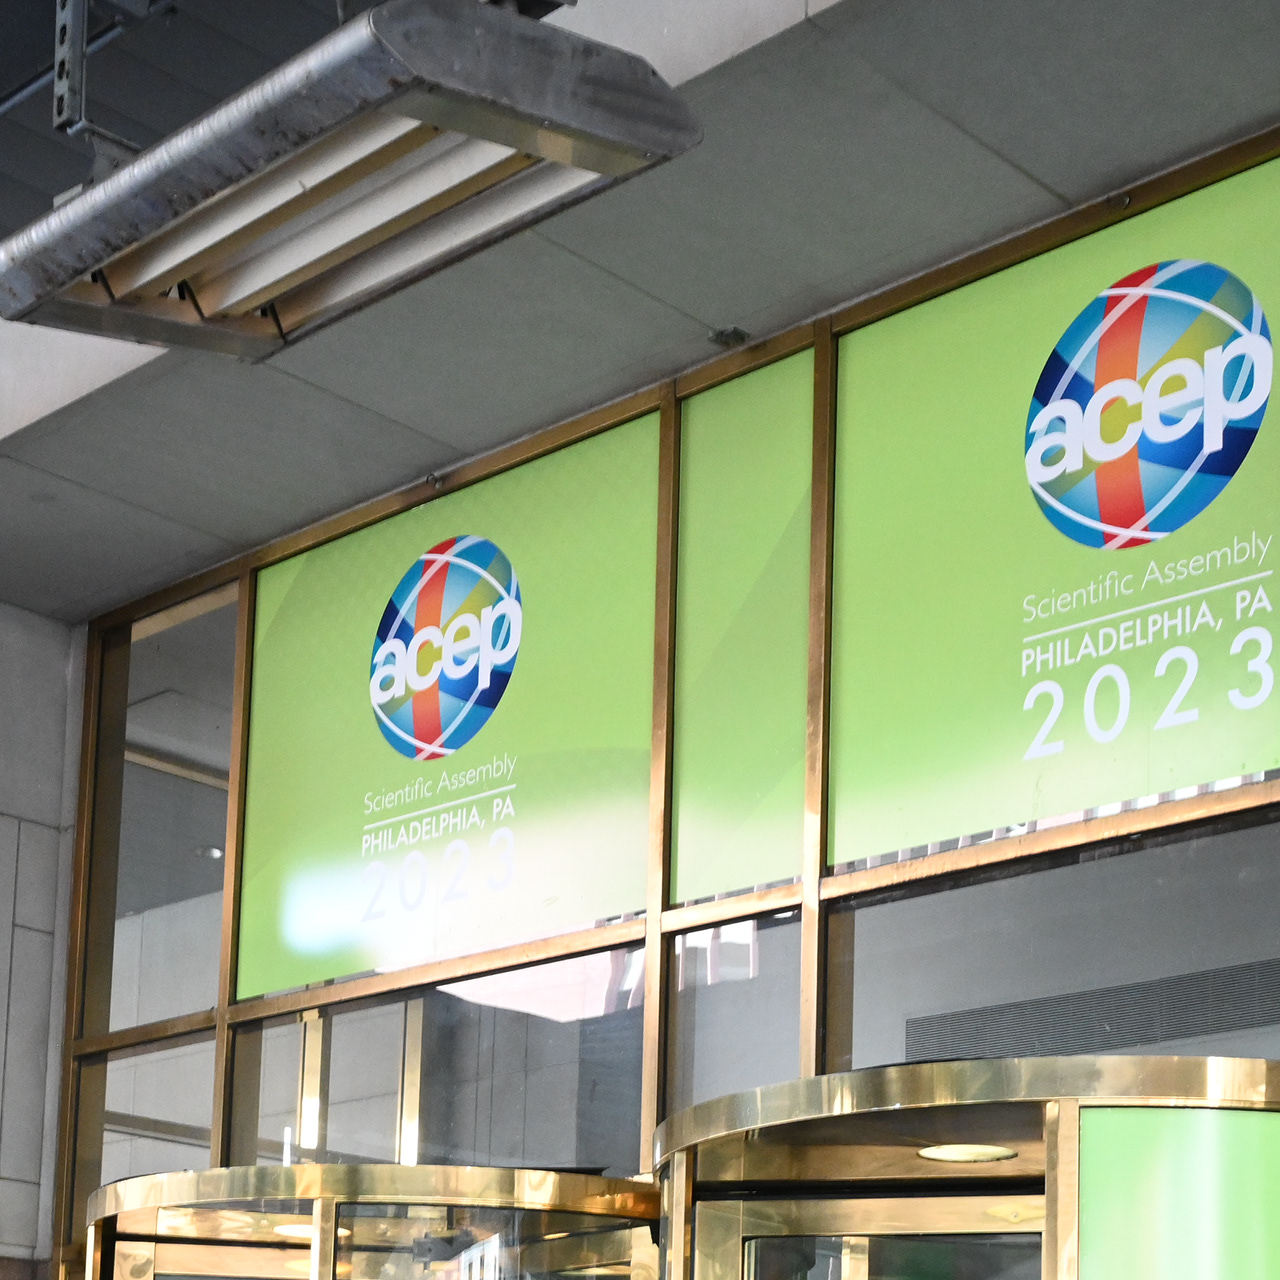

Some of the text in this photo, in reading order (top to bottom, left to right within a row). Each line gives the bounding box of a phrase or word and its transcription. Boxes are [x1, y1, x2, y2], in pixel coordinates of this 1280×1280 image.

[1025, 332, 1273, 484] acep
[1023, 530, 1273, 623] Scientific Assembly
[369, 598, 522, 704] acep
[1021, 584, 1273, 678] PHILADELPHIA, PA
[1022, 626, 1274, 762] 2023
[361, 795, 515, 858] PHILADELPHIA, PA
[364, 752, 517, 814] Scientific Assembly
[360, 826, 515, 923] 2023
